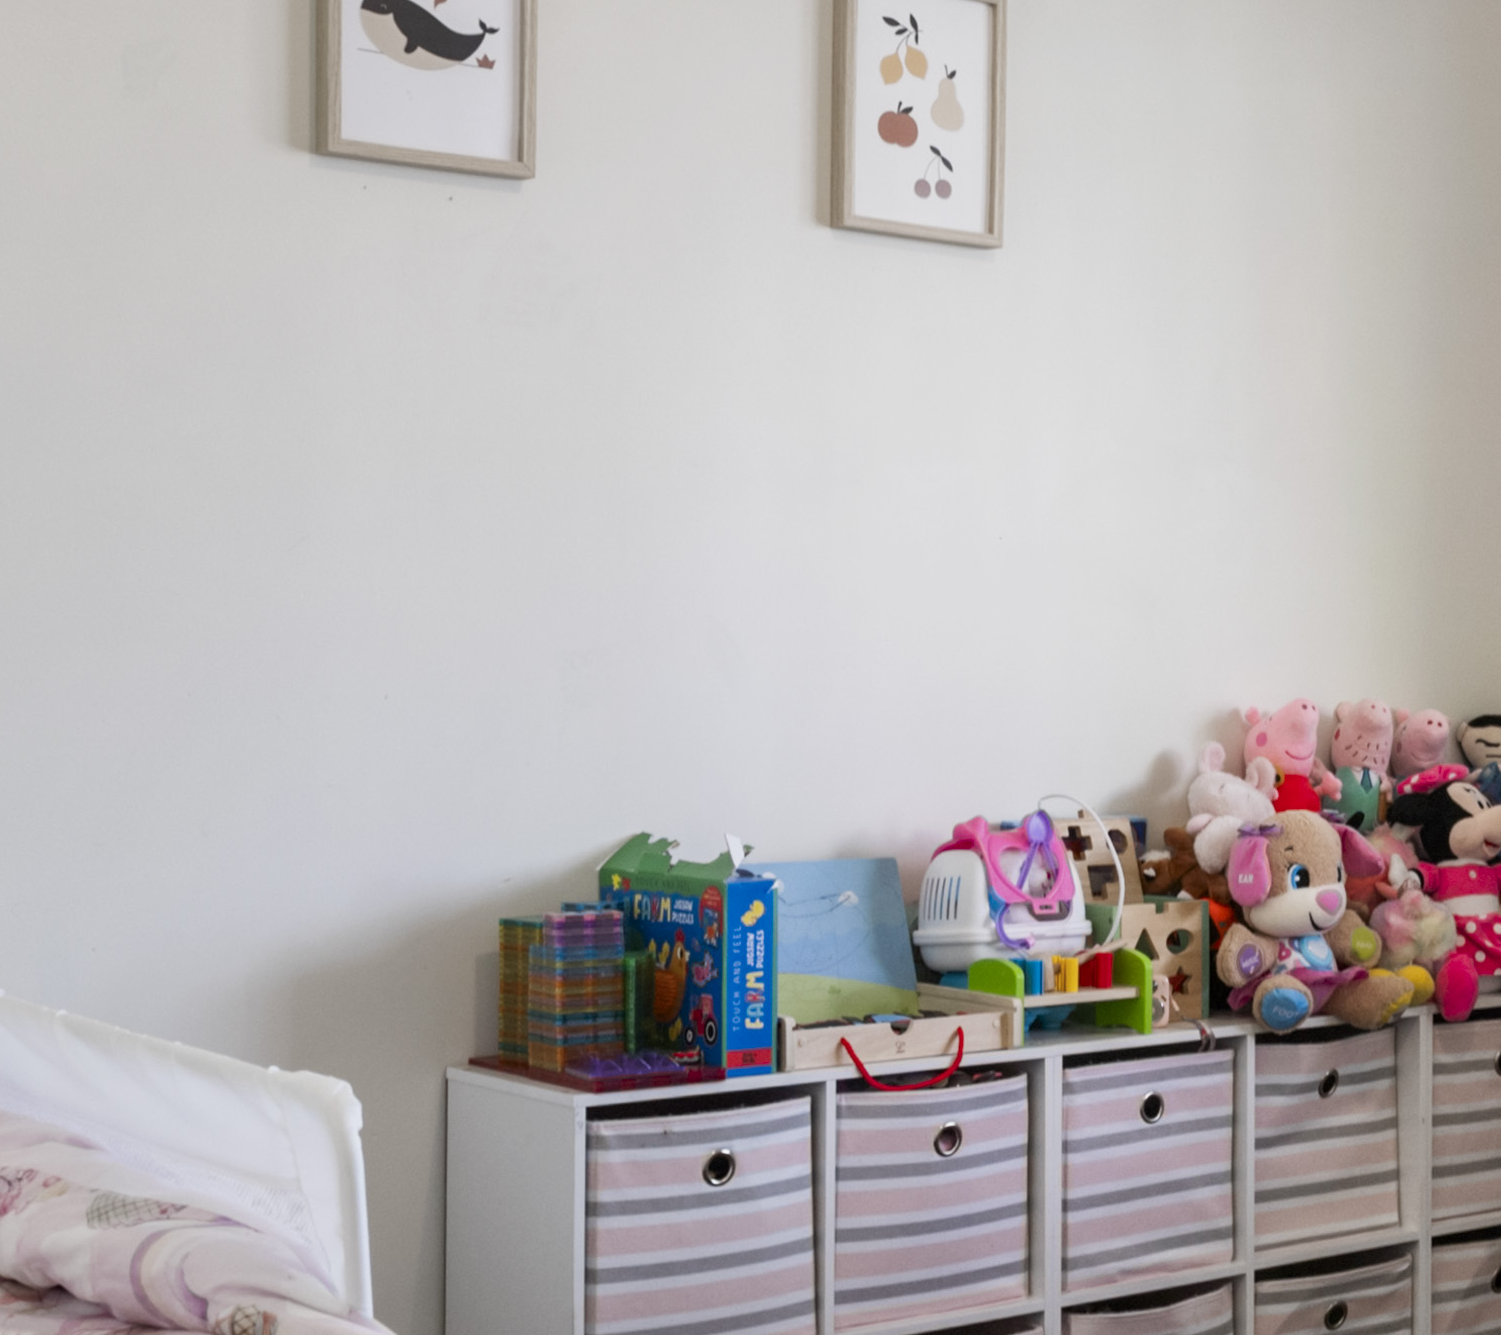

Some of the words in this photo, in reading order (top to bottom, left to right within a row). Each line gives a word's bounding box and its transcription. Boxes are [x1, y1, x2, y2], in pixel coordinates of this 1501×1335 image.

[1238, 873, 1254, 884] EAR
[633, 894, 671, 922] FARM
[733, 925, 742, 954] FEEL
[746, 931, 756, 967] JIGSAW
[755, 929, 765, 969] PUZZLES
[733, 960, 742, 984] AND
[732, 991, 741, 1032] TOUCH
[745, 971, 765, 1030] FARM
